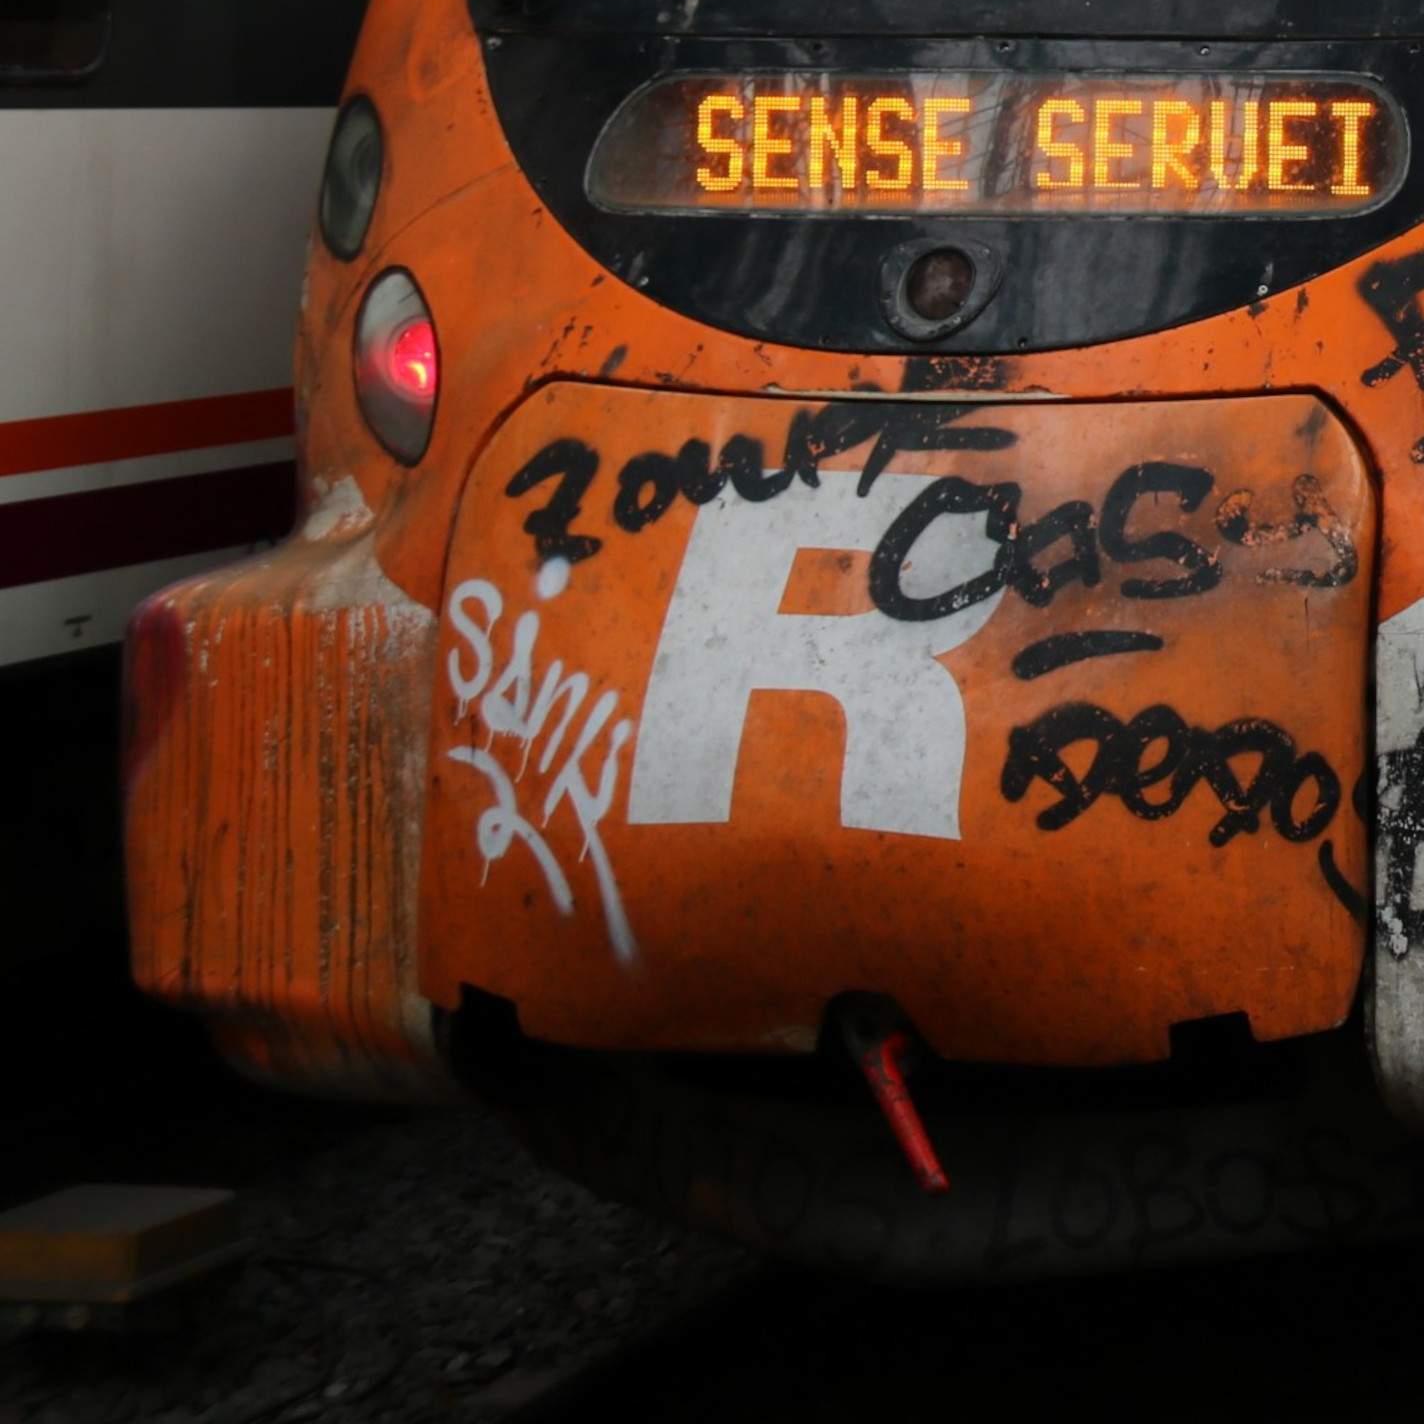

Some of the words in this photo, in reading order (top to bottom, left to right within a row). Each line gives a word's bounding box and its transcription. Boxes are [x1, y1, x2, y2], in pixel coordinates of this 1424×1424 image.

[695, 95, 971, 192] SENSE
[1036, 98, 1375, 196] SERVEI
[628, 468, 1005, 841] R
